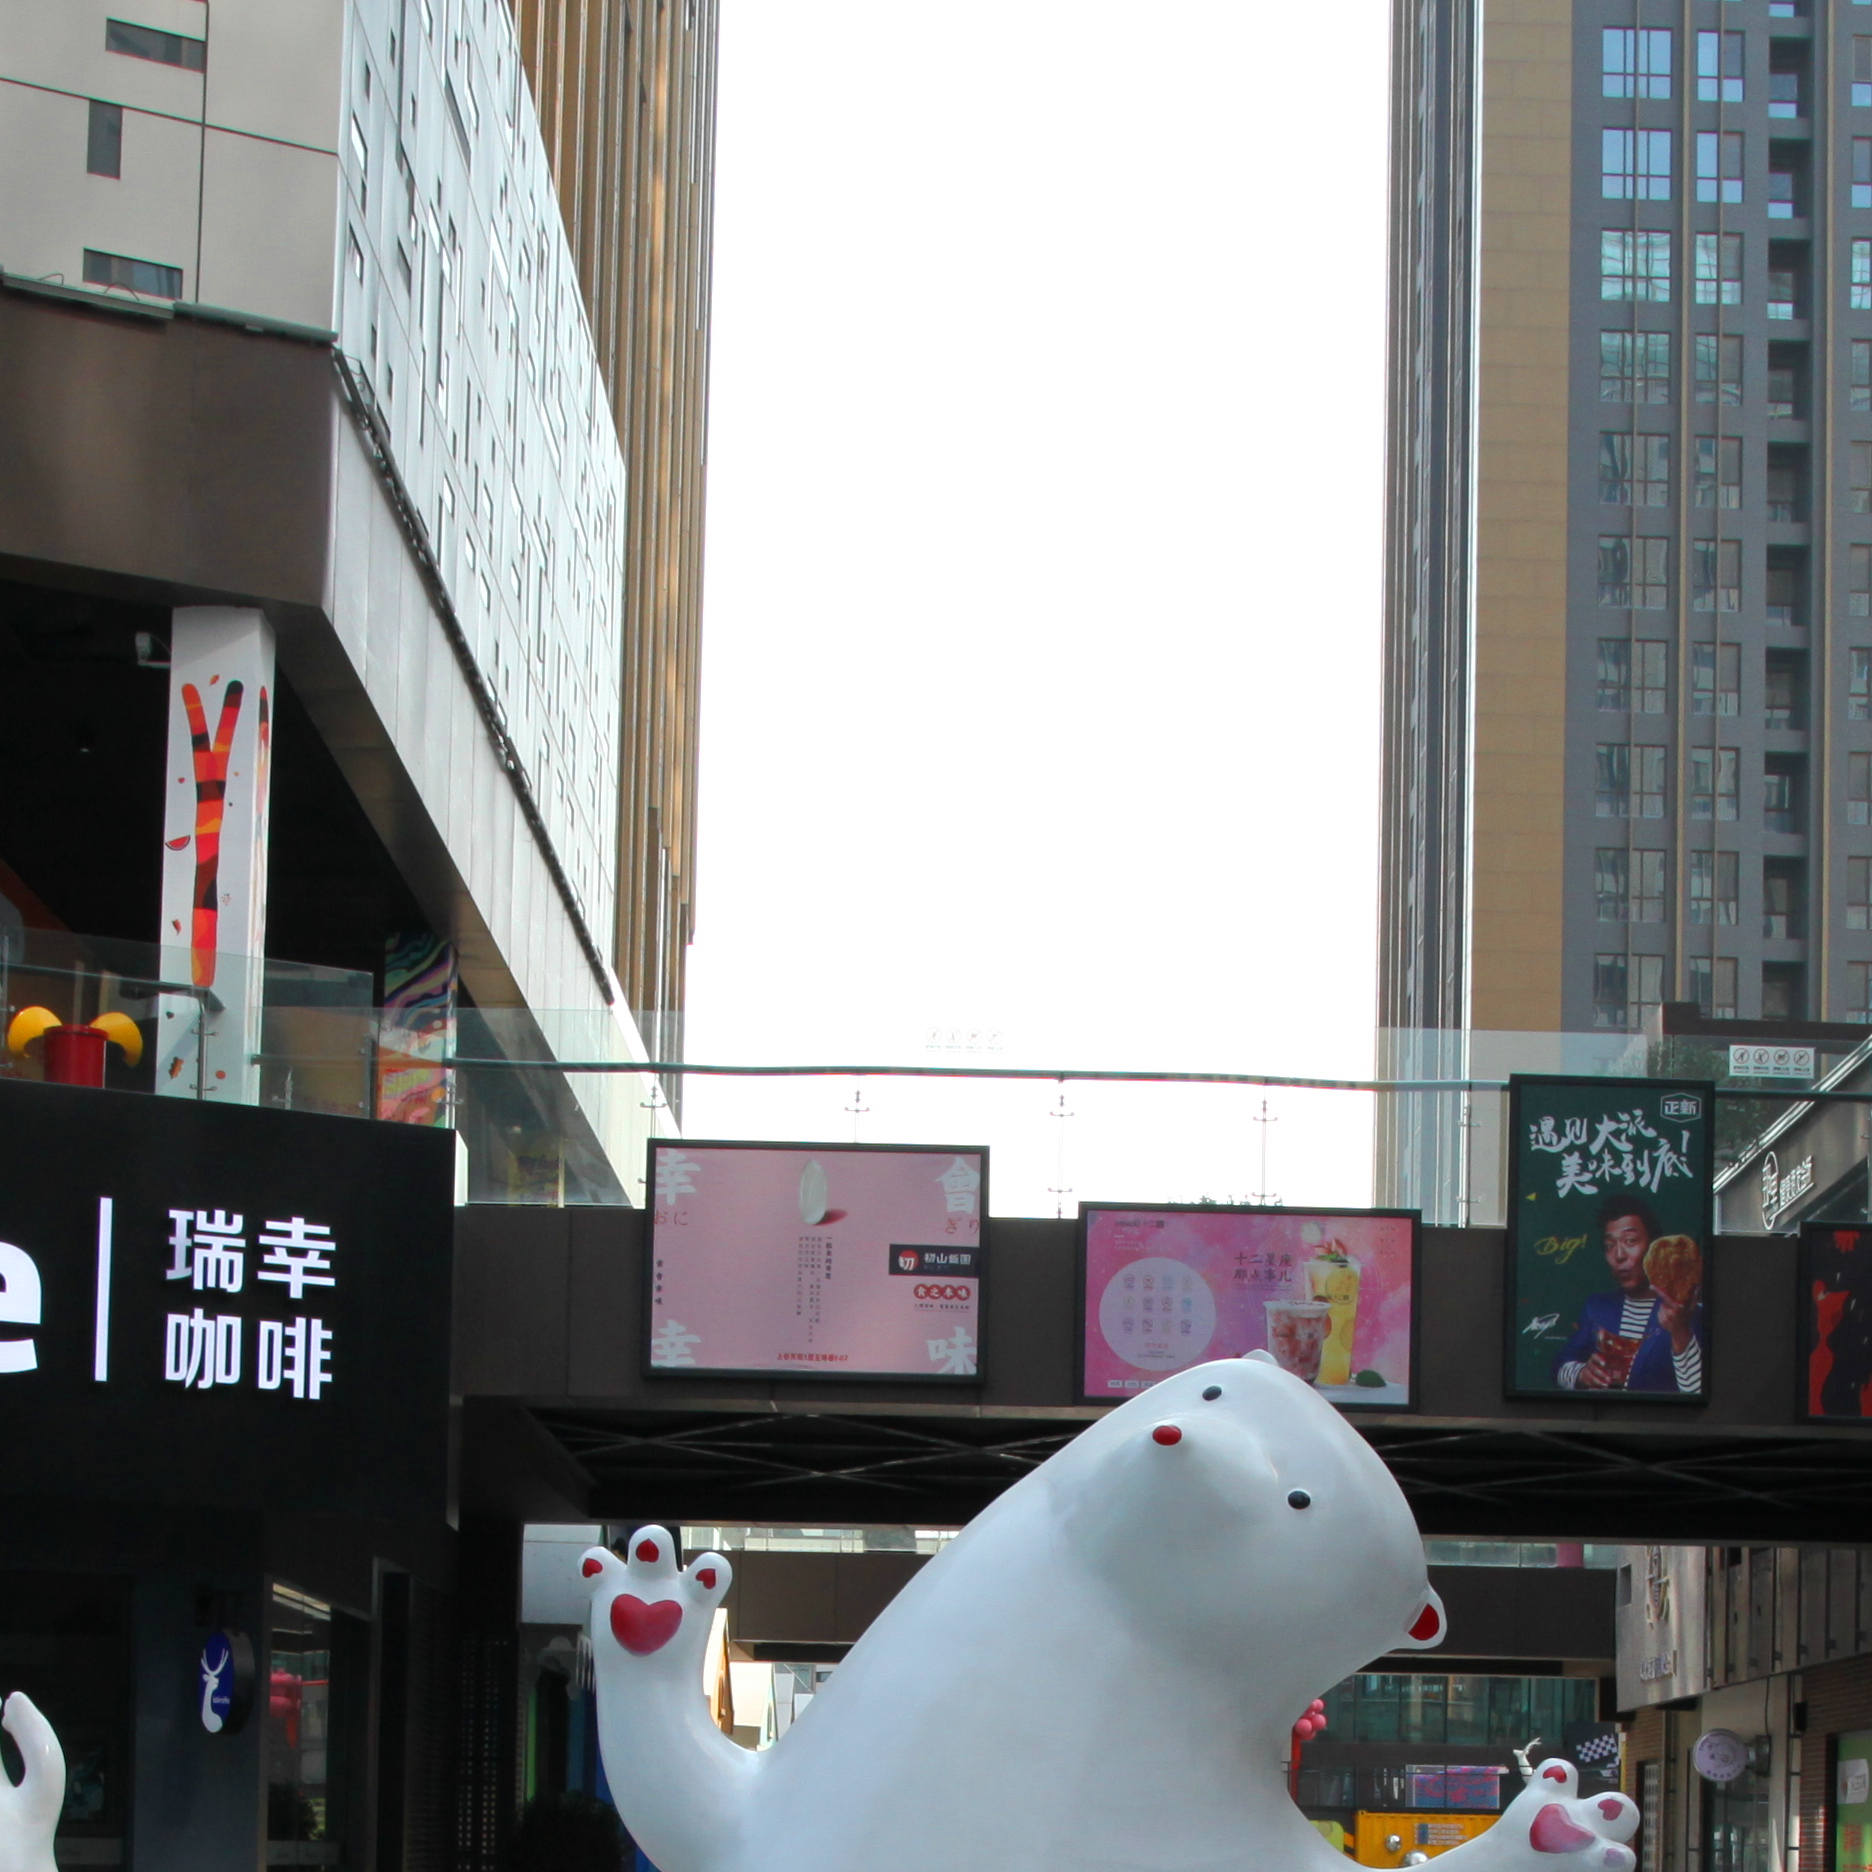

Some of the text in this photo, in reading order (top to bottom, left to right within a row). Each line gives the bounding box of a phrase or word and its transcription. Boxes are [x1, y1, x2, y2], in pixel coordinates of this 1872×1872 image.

[1664, 1100, 1696, 1116] 正新
[166, 1208, 336, 1301] 瑞幸
[164, 1311, 333, 1400] 咖啡
